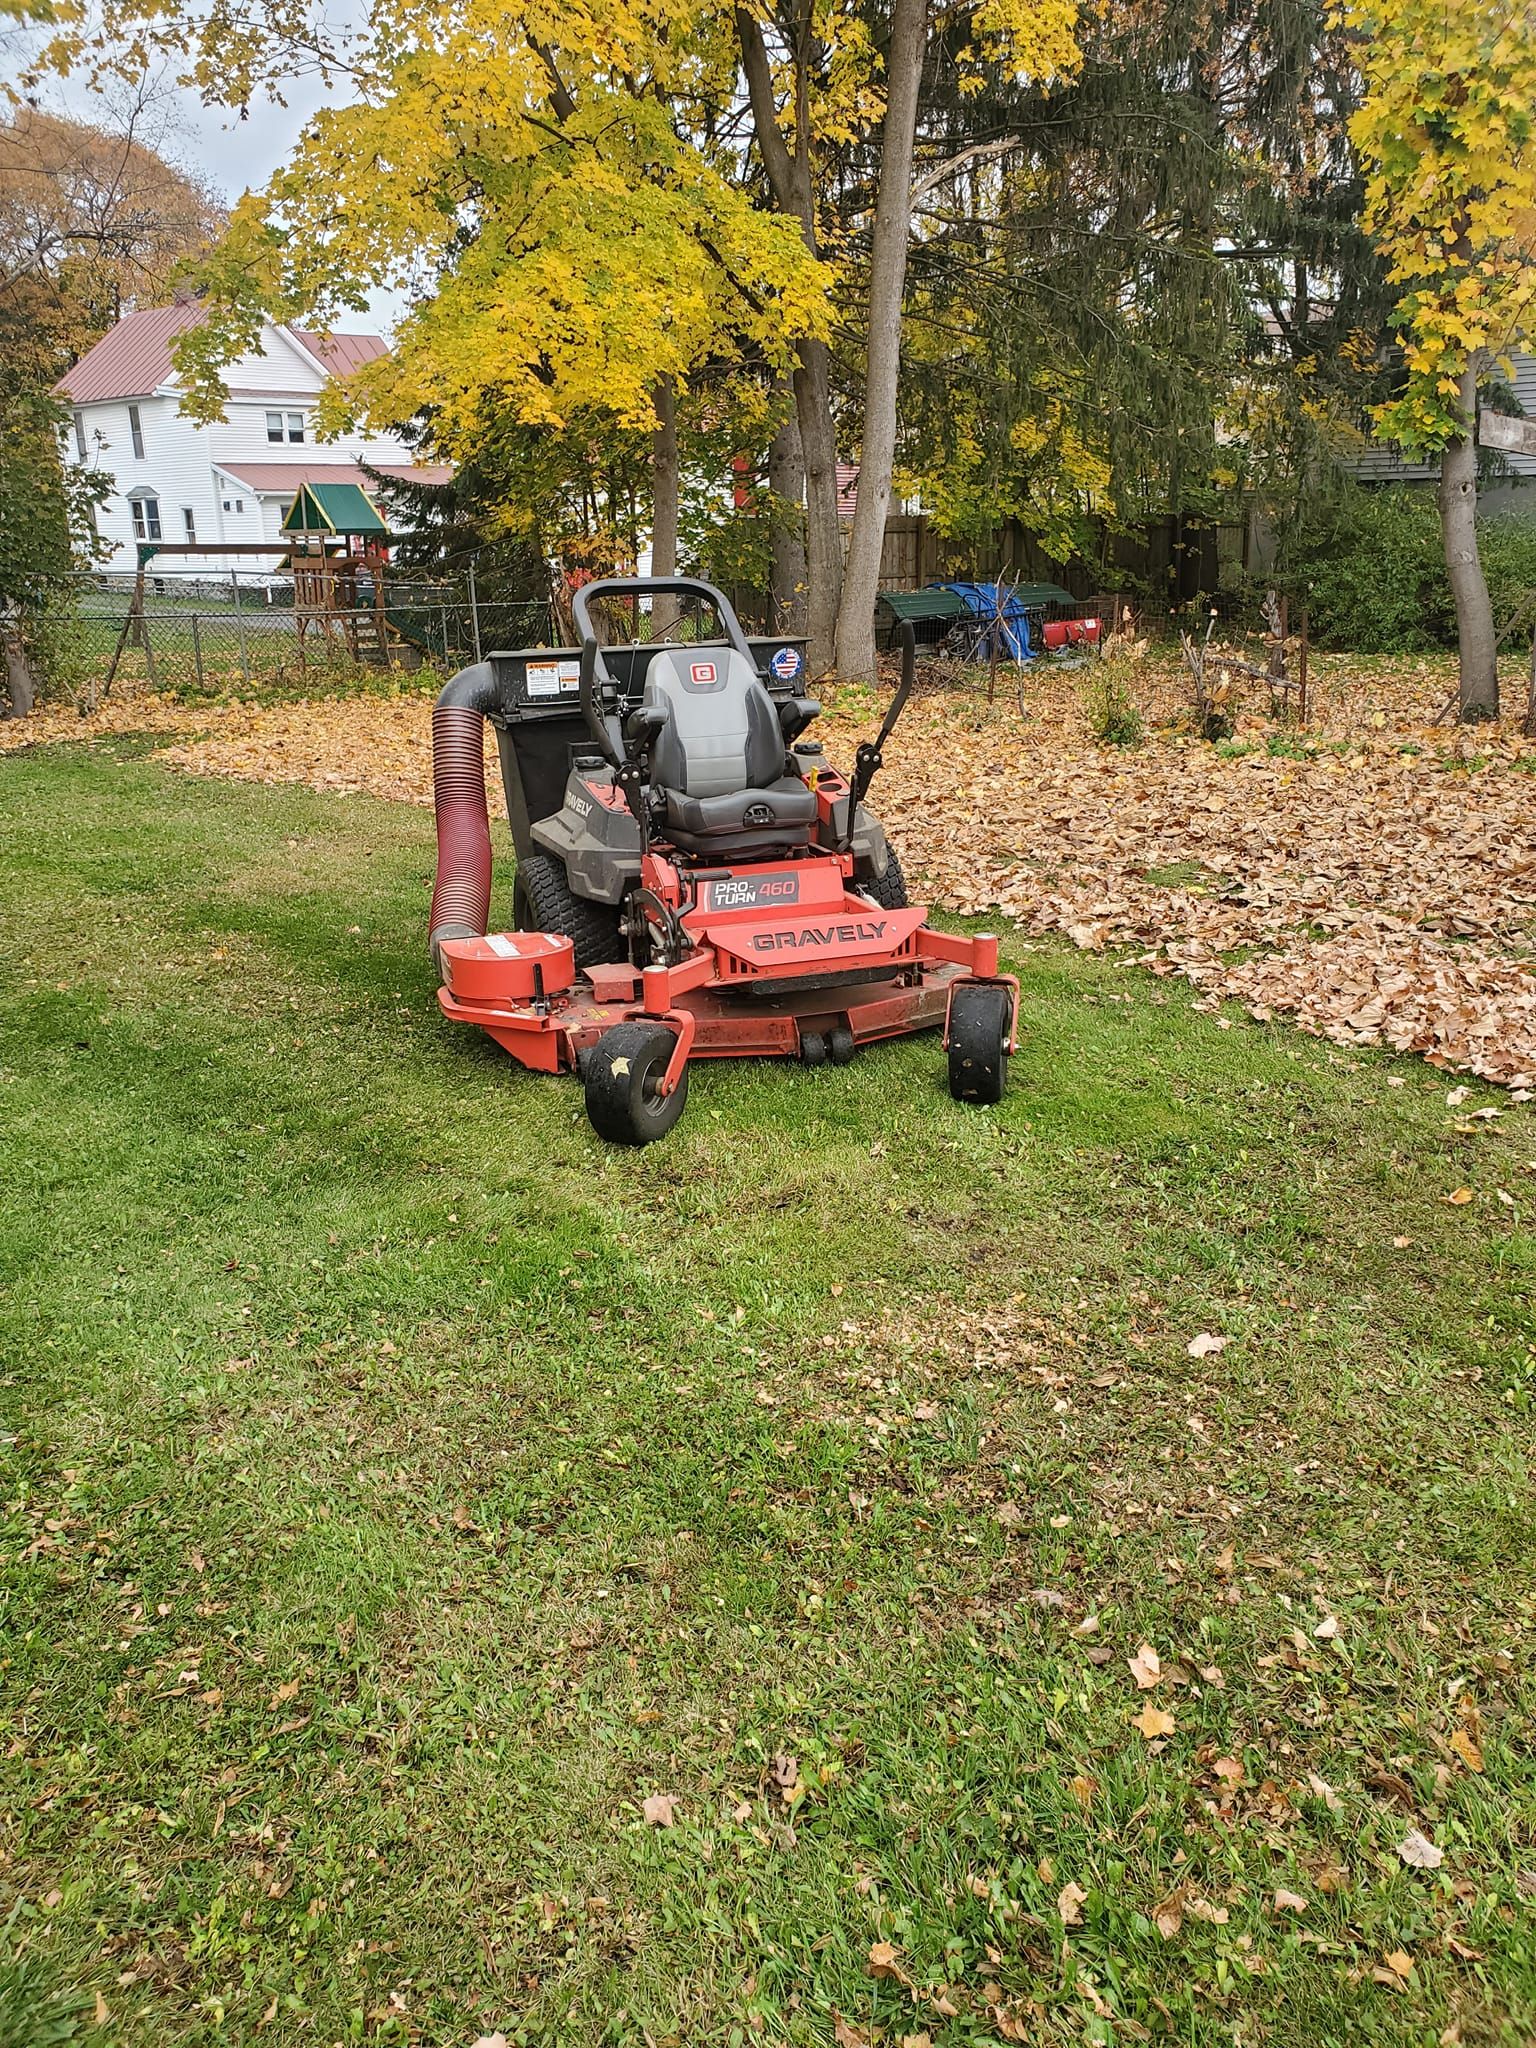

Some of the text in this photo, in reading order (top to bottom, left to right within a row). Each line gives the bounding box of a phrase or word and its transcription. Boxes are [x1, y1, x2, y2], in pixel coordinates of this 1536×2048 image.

[715, 881, 755, 895] PRO-
[759, 880, 795, 897] 460
[714, 891, 757, 906] TURN
[753, 921, 887, 951] GRAVELY
